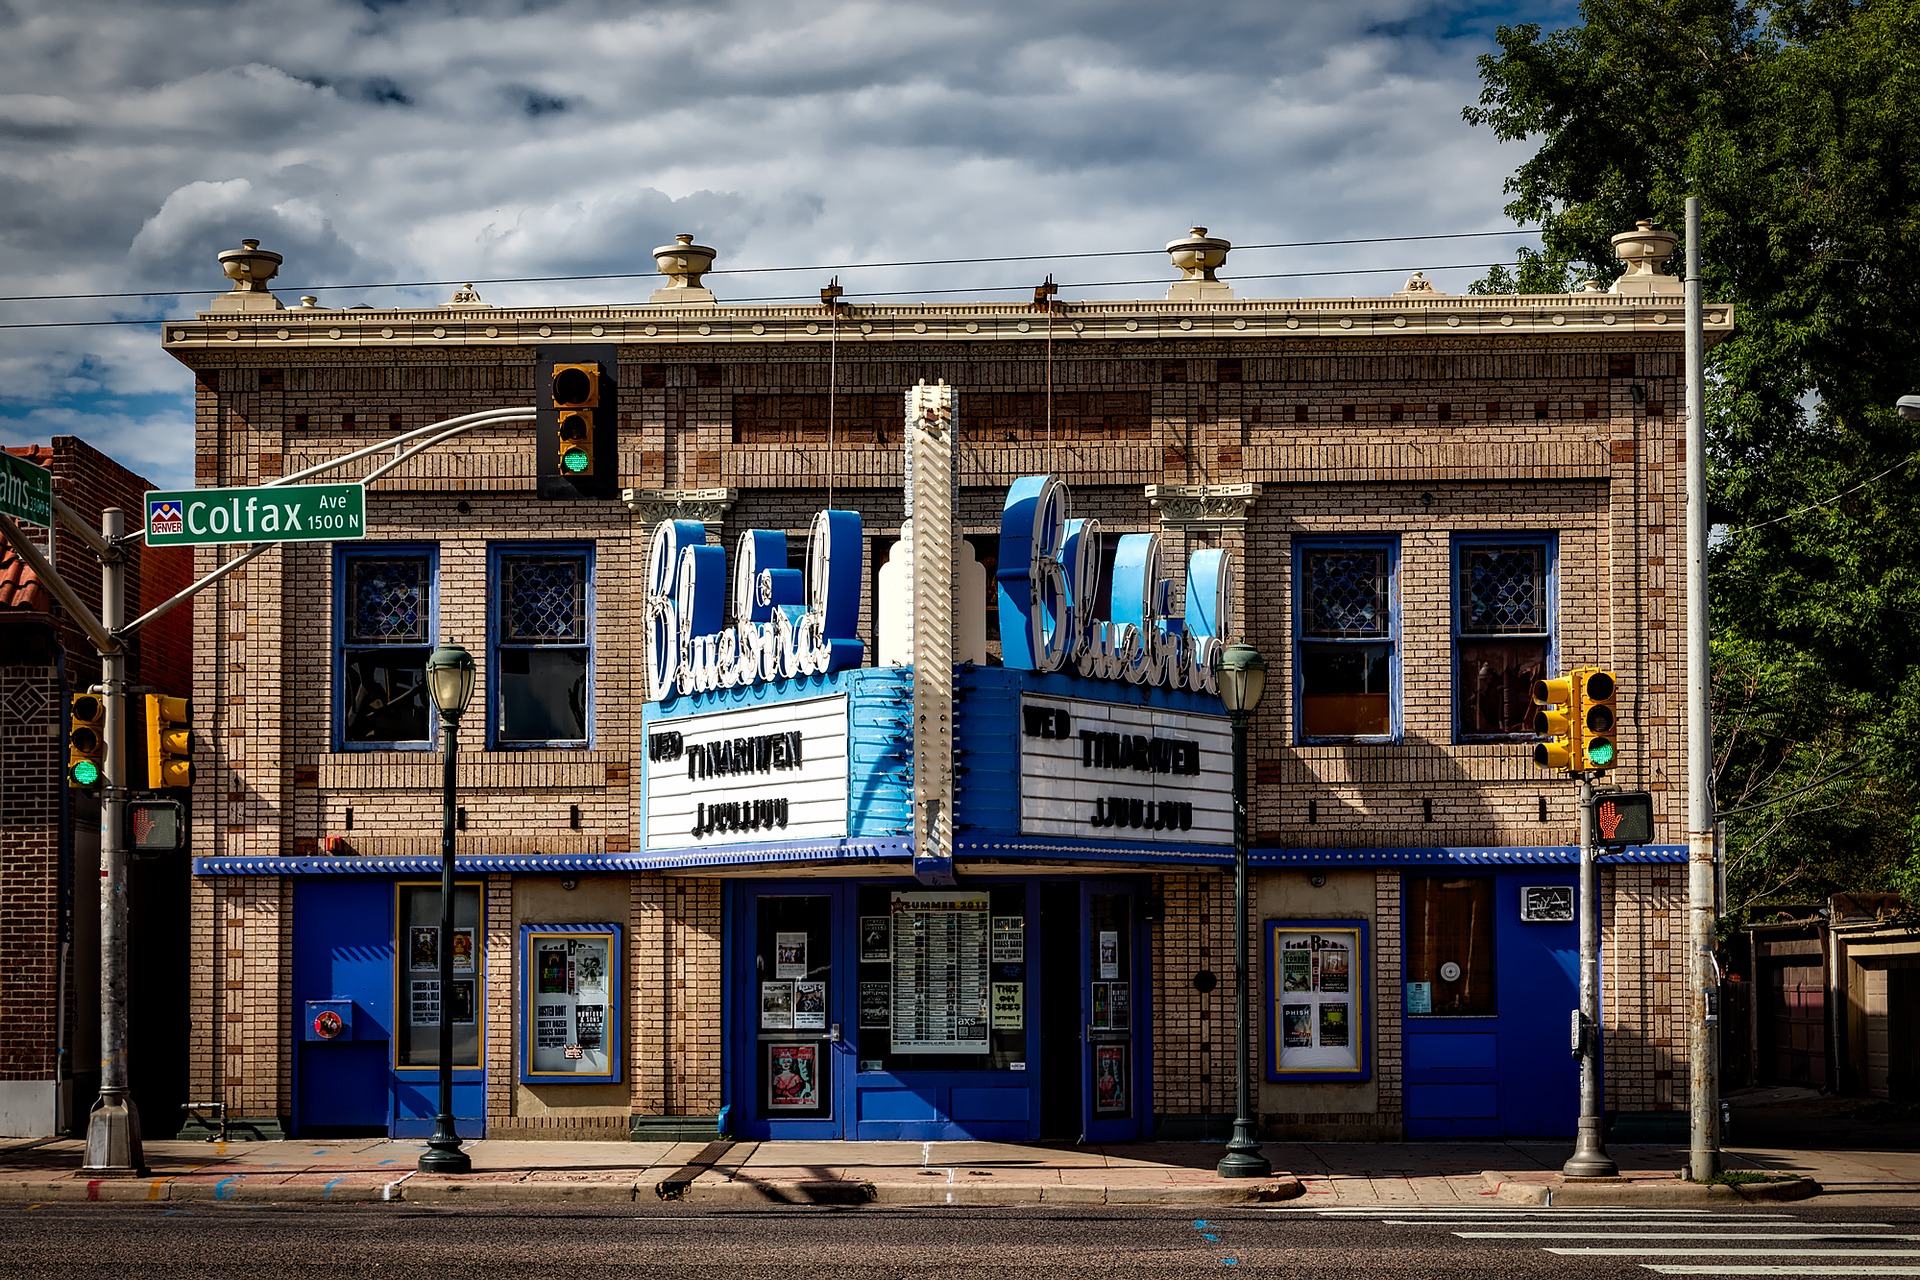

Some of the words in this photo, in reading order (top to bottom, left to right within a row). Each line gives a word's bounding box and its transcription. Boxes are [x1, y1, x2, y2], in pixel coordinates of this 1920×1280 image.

[319, 494, 347, 509] Ave
[187, 496, 303, 535] Colfax
[307, 514, 344, 531] 1500
[349, 513, 359, 528] N
[151, 522, 183, 534] DENVER
[1022, 704, 1072, 740] WED
[648, 730, 684, 763] WED
[1079, 729, 1202, 776] TINARIWEN
[685, 730, 803, 781] TINARIWEN
[904, 901, 956, 910] SUMMER
[960, 900, 988, 910] 2015
[995, 984, 1019, 994] THEE
[995, 1003, 1020, 1011] SEES
[957, 1018, 976, 1026] axs
